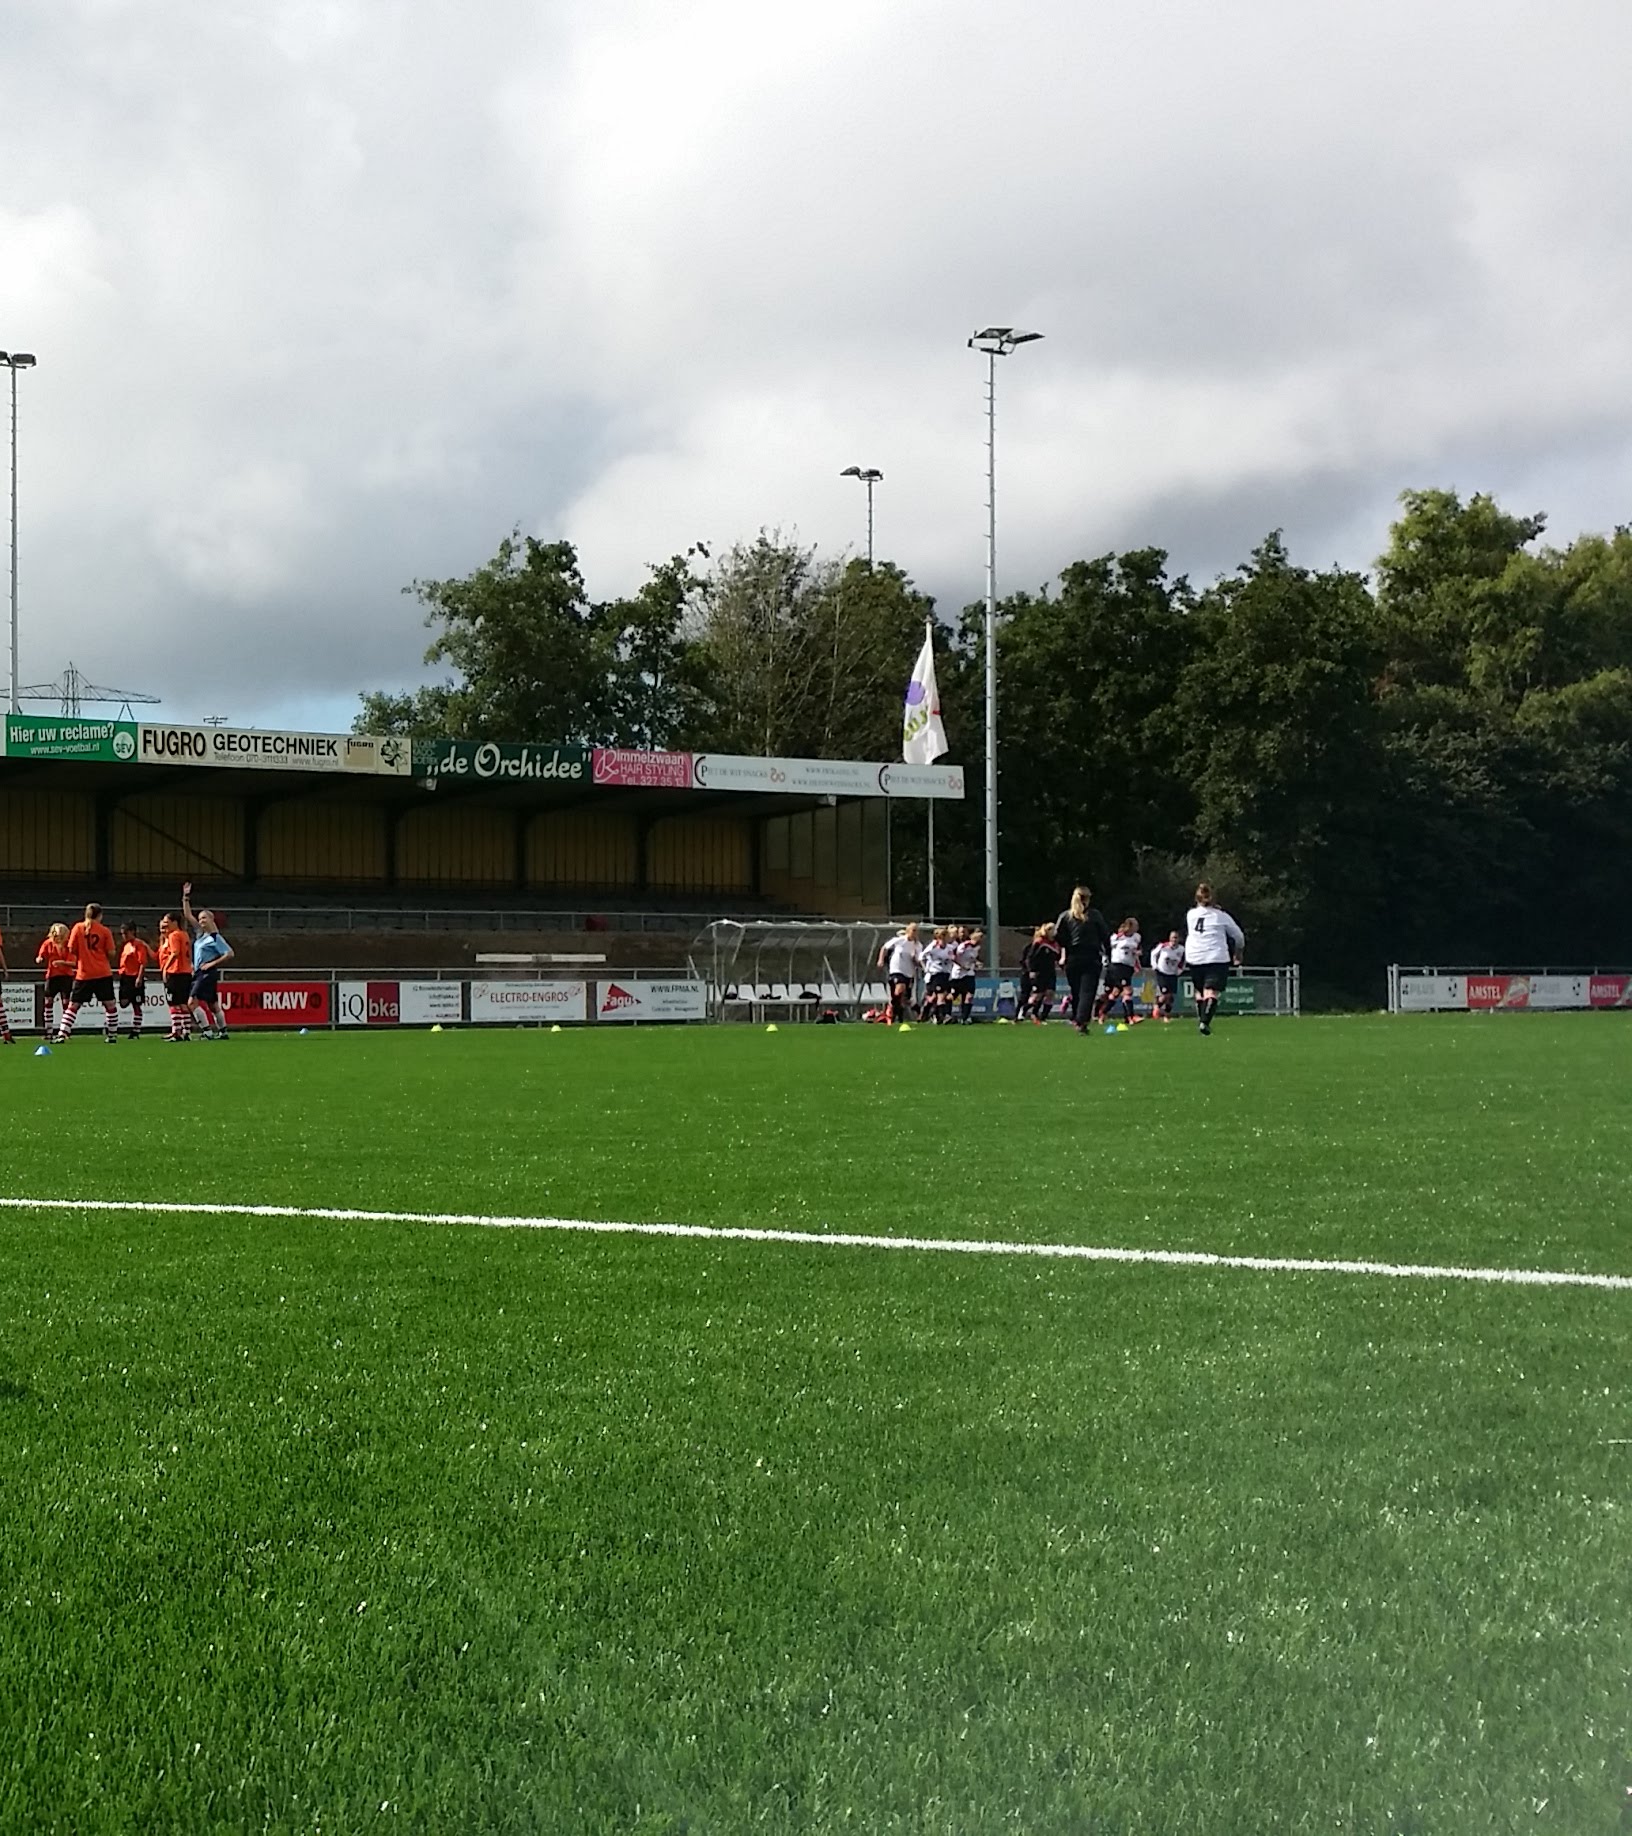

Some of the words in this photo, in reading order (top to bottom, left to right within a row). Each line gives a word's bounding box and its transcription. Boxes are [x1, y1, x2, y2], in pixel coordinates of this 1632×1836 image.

[9, 725, 35, 744] Hier
[38, 727, 57, 742] uw
[60, 721, 116, 742] reclame?
[30, 741, 101, 756] www.sev-voetbal.nl
[115, 742, 133, 755] SEV
[142, 728, 208, 758] FUGRO
[212, 732, 339, 757] GEOTECHNIEK
[620, 763, 644, 775] HAIR
[645, 764, 685, 777] STYLING
[640, 776, 658, 786] 327
[1194, 916, 1206, 934] 4
[84, 933, 100, 950] 12
[490, 990, 569, 1003] ELECTRO-ENGROS
[1469, 984, 1502, 1000] AMSTEL
[1591, 985, 1622, 999] AMSTEL
[368, 998, 399, 1017] bka
